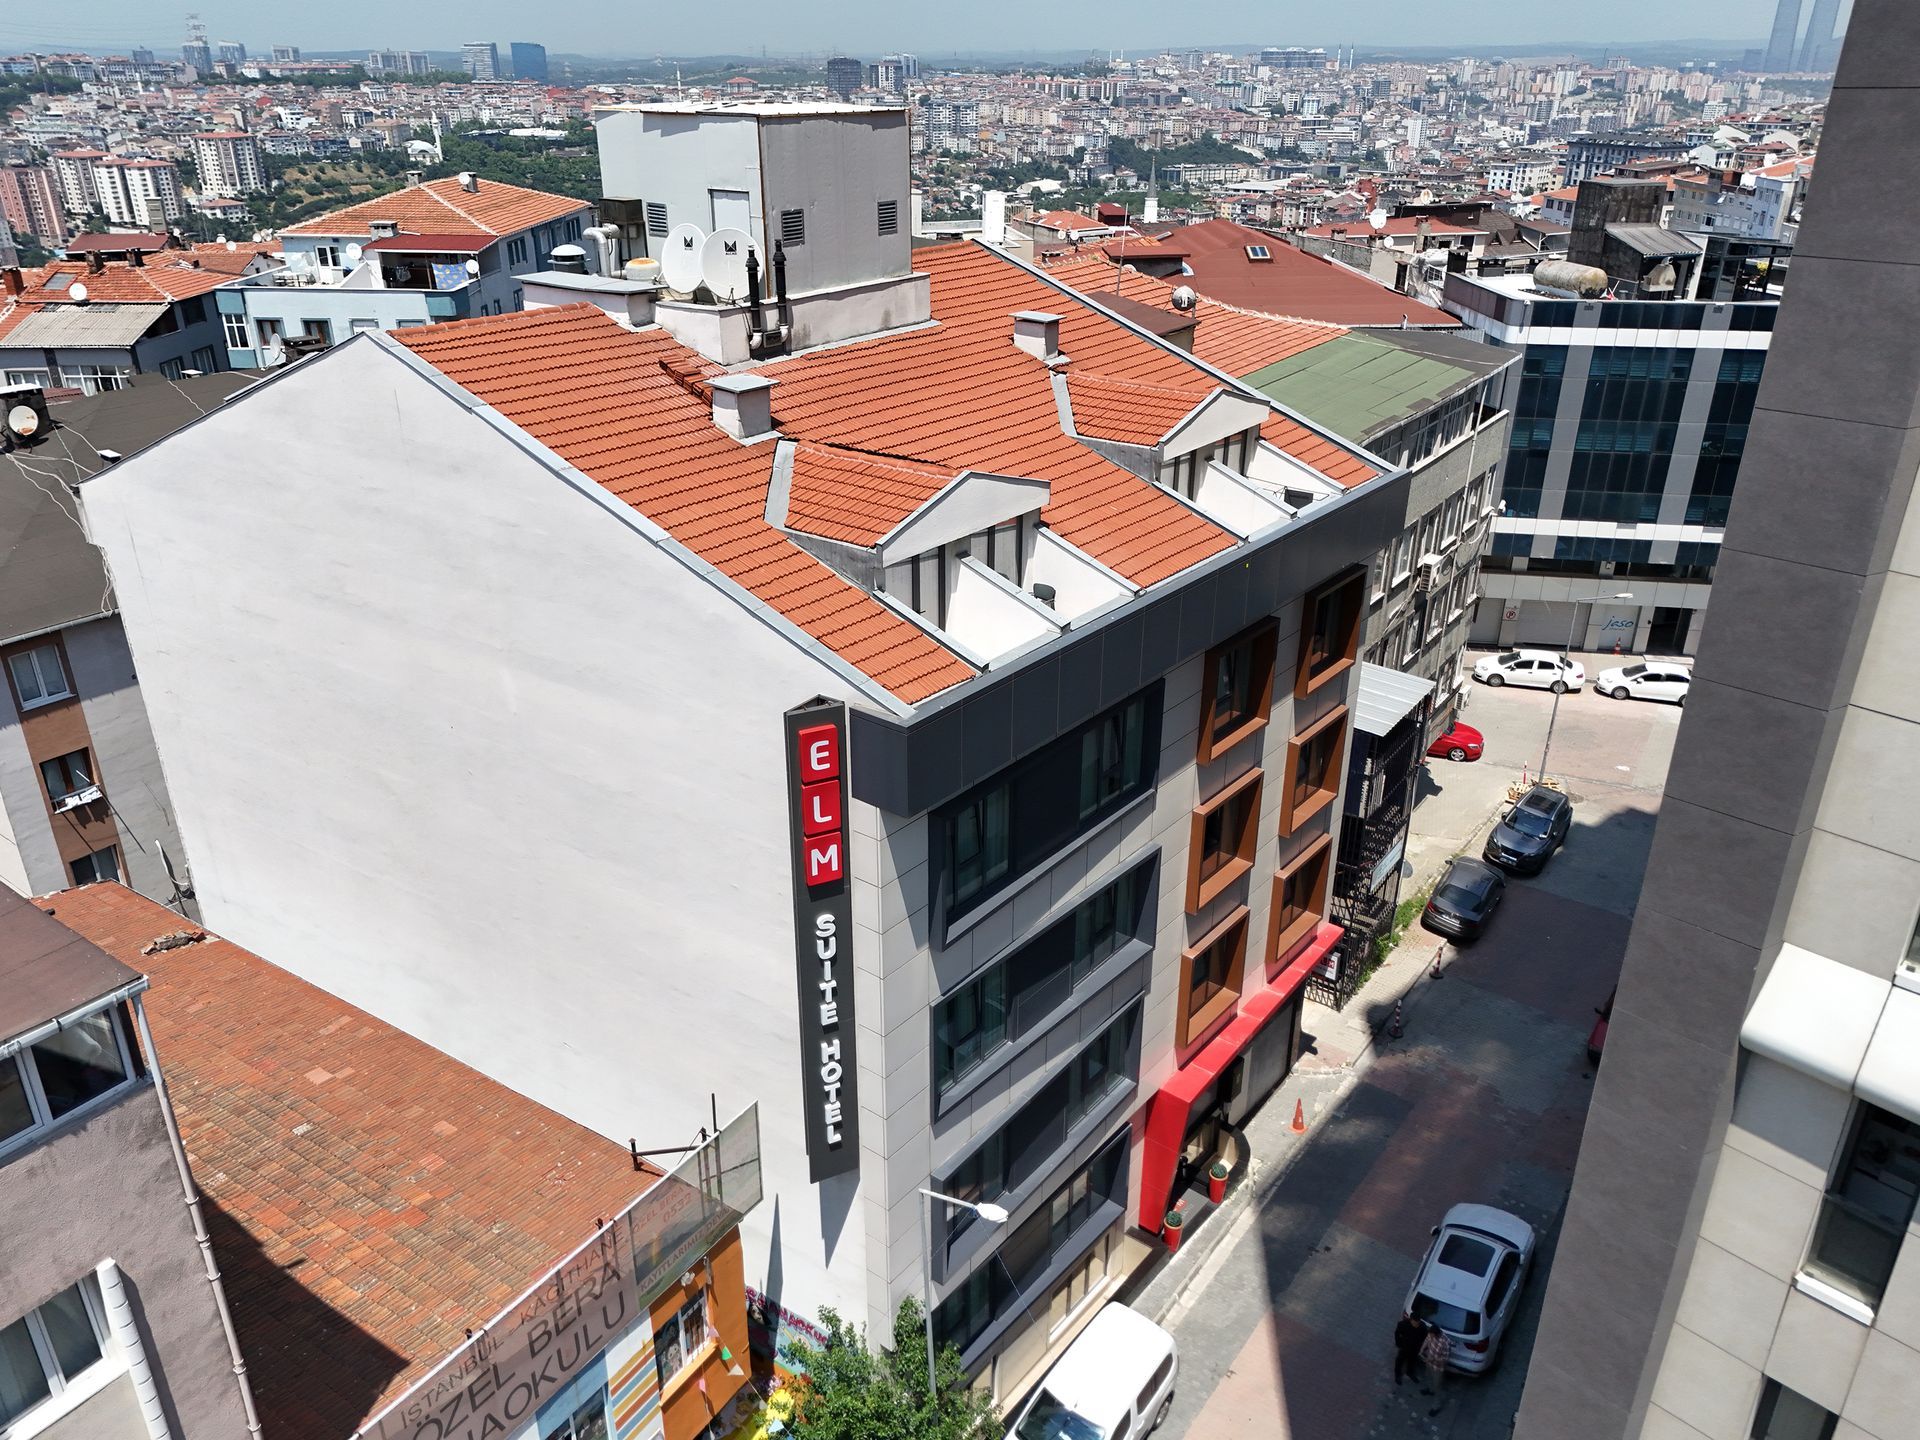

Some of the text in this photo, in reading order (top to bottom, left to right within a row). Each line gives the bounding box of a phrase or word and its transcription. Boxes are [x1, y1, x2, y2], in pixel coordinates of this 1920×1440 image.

[810, 739, 838, 876] ELM
[816, 913, 839, 1026] SUITE
[820, 1039, 843, 1144] HOTEL
[412, 1262, 621, 1440] ÖZEL BERA
